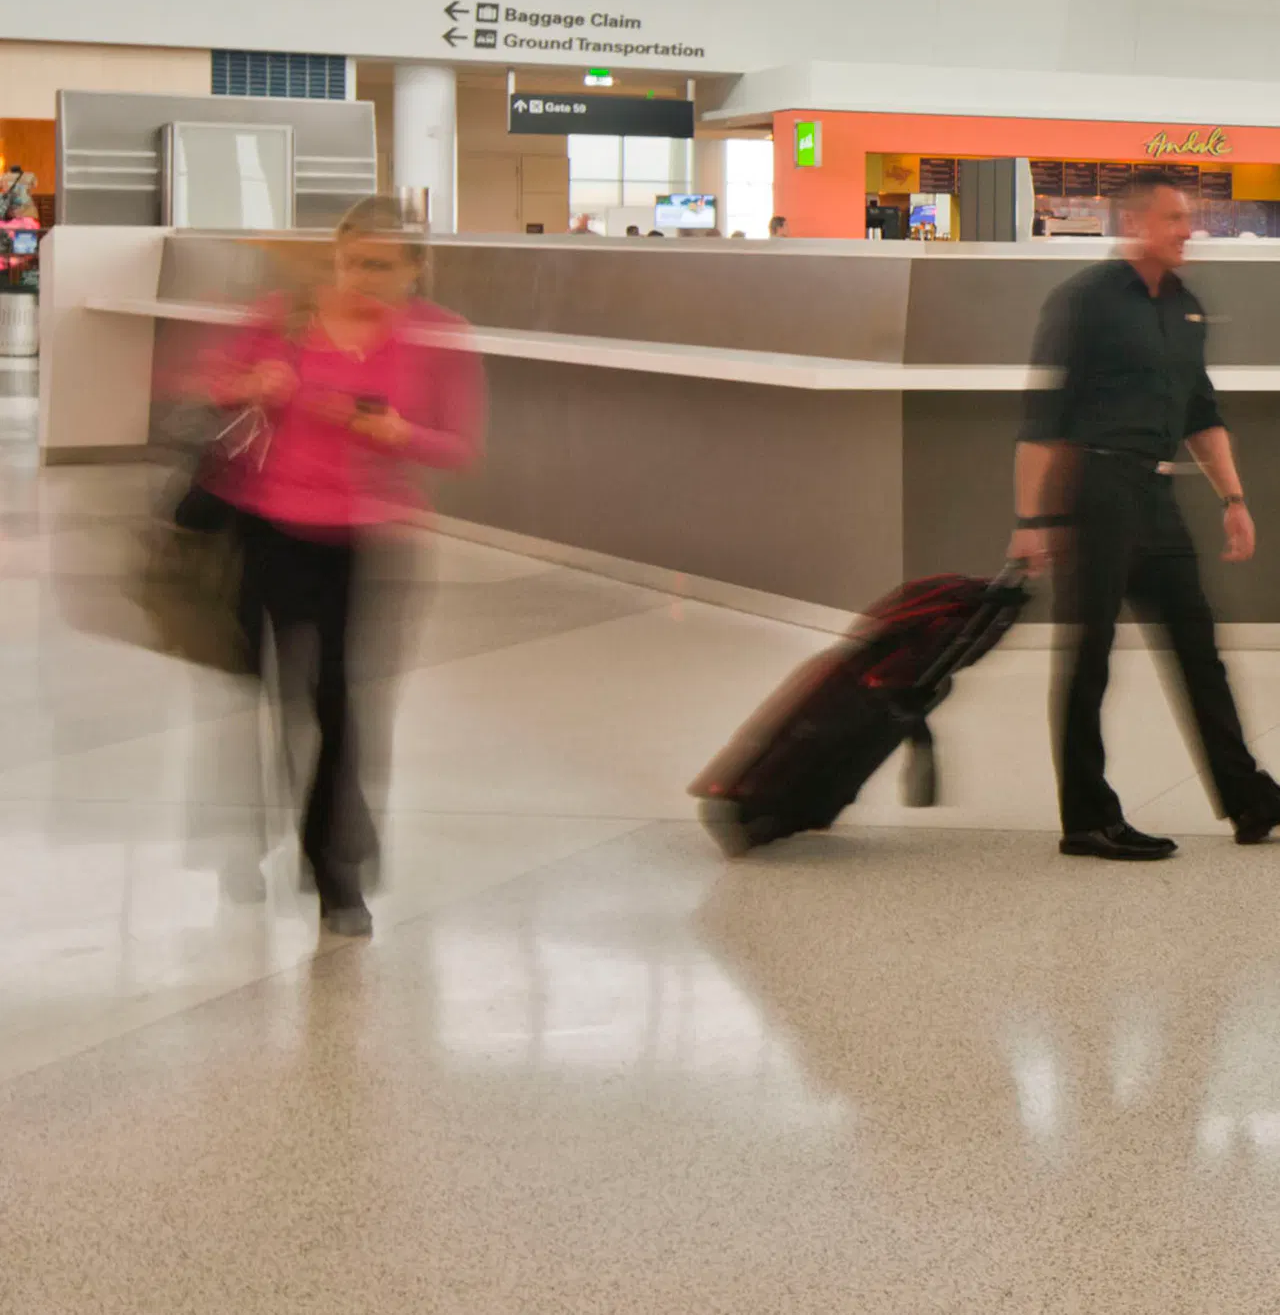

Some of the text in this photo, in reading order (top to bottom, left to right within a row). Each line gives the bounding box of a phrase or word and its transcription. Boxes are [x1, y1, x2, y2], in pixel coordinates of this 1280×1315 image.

[504, 7, 641, 29] Baggage Claim
[503, 33, 705, 58] Ground Transportation
[545, 102, 571, 113] Gate
